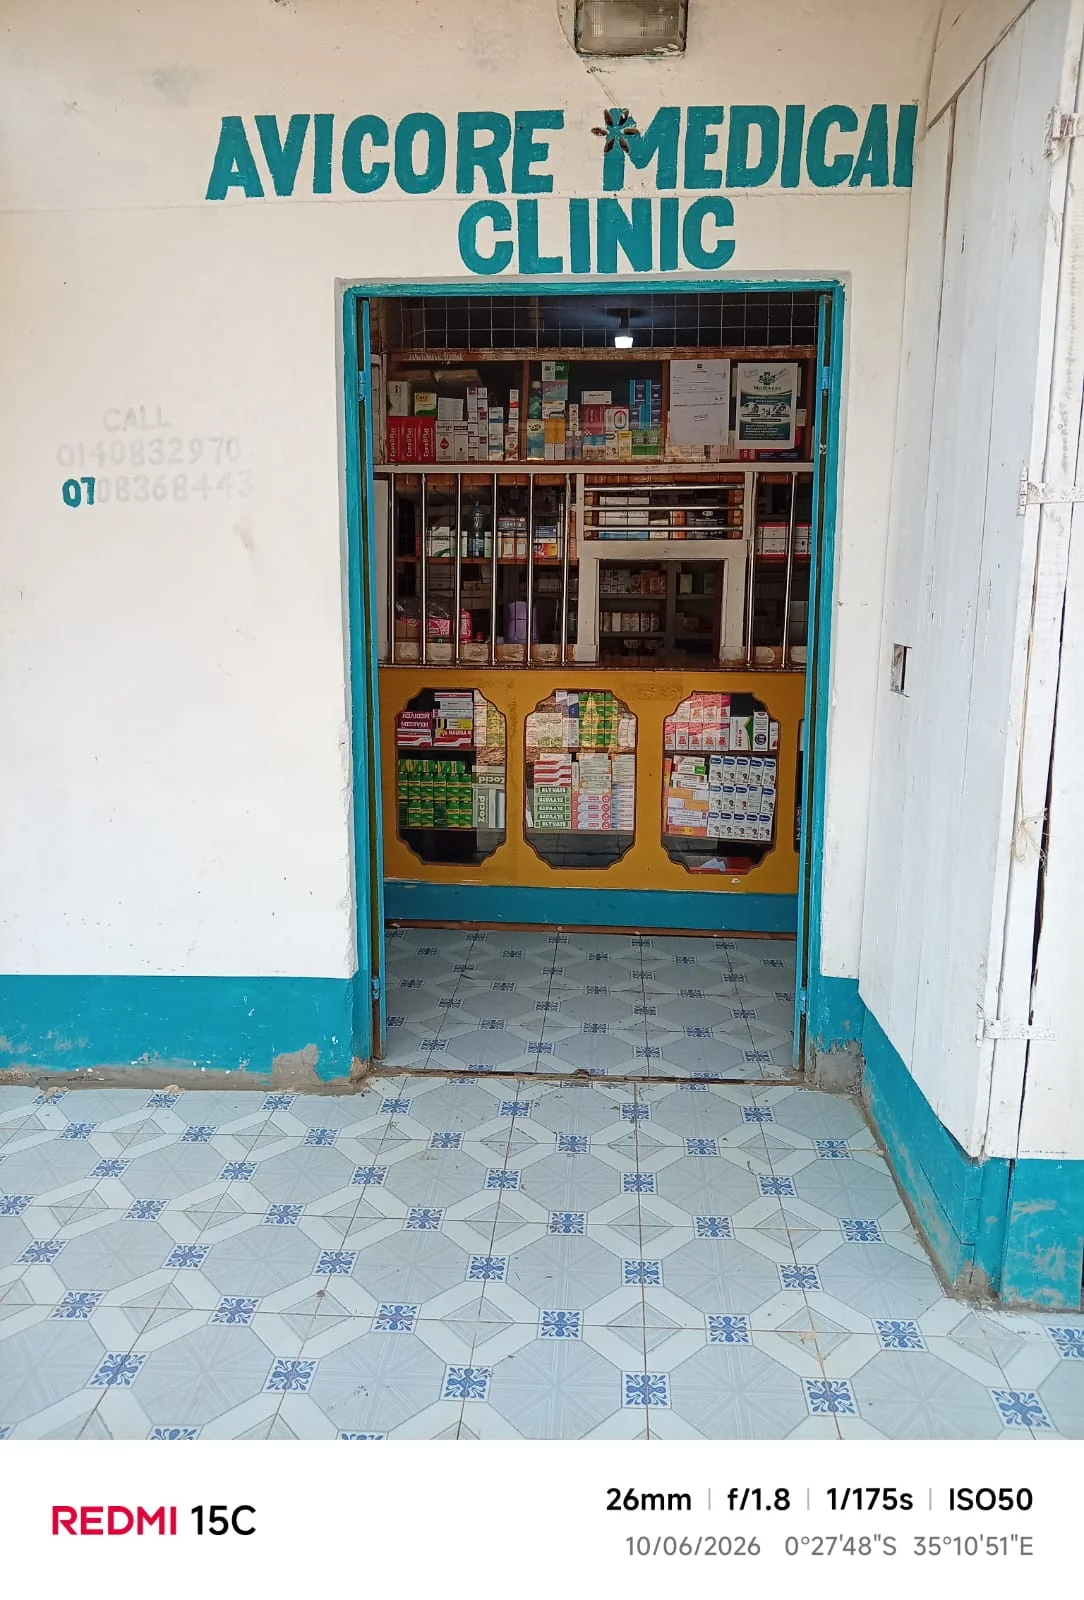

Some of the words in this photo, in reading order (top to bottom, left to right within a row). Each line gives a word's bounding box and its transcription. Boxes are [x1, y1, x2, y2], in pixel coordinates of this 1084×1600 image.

[205, 110, 565, 200] AVICORE
[458, 195, 737, 275] CLINIC
[103, 404, 171, 432] CALL
[57, 436, 242, 468] 0140832970
[62, 470, 255, 508] 0708368443
[478, 776, 504, 784] Zocid
[478, 795, 486, 823] Zocid
